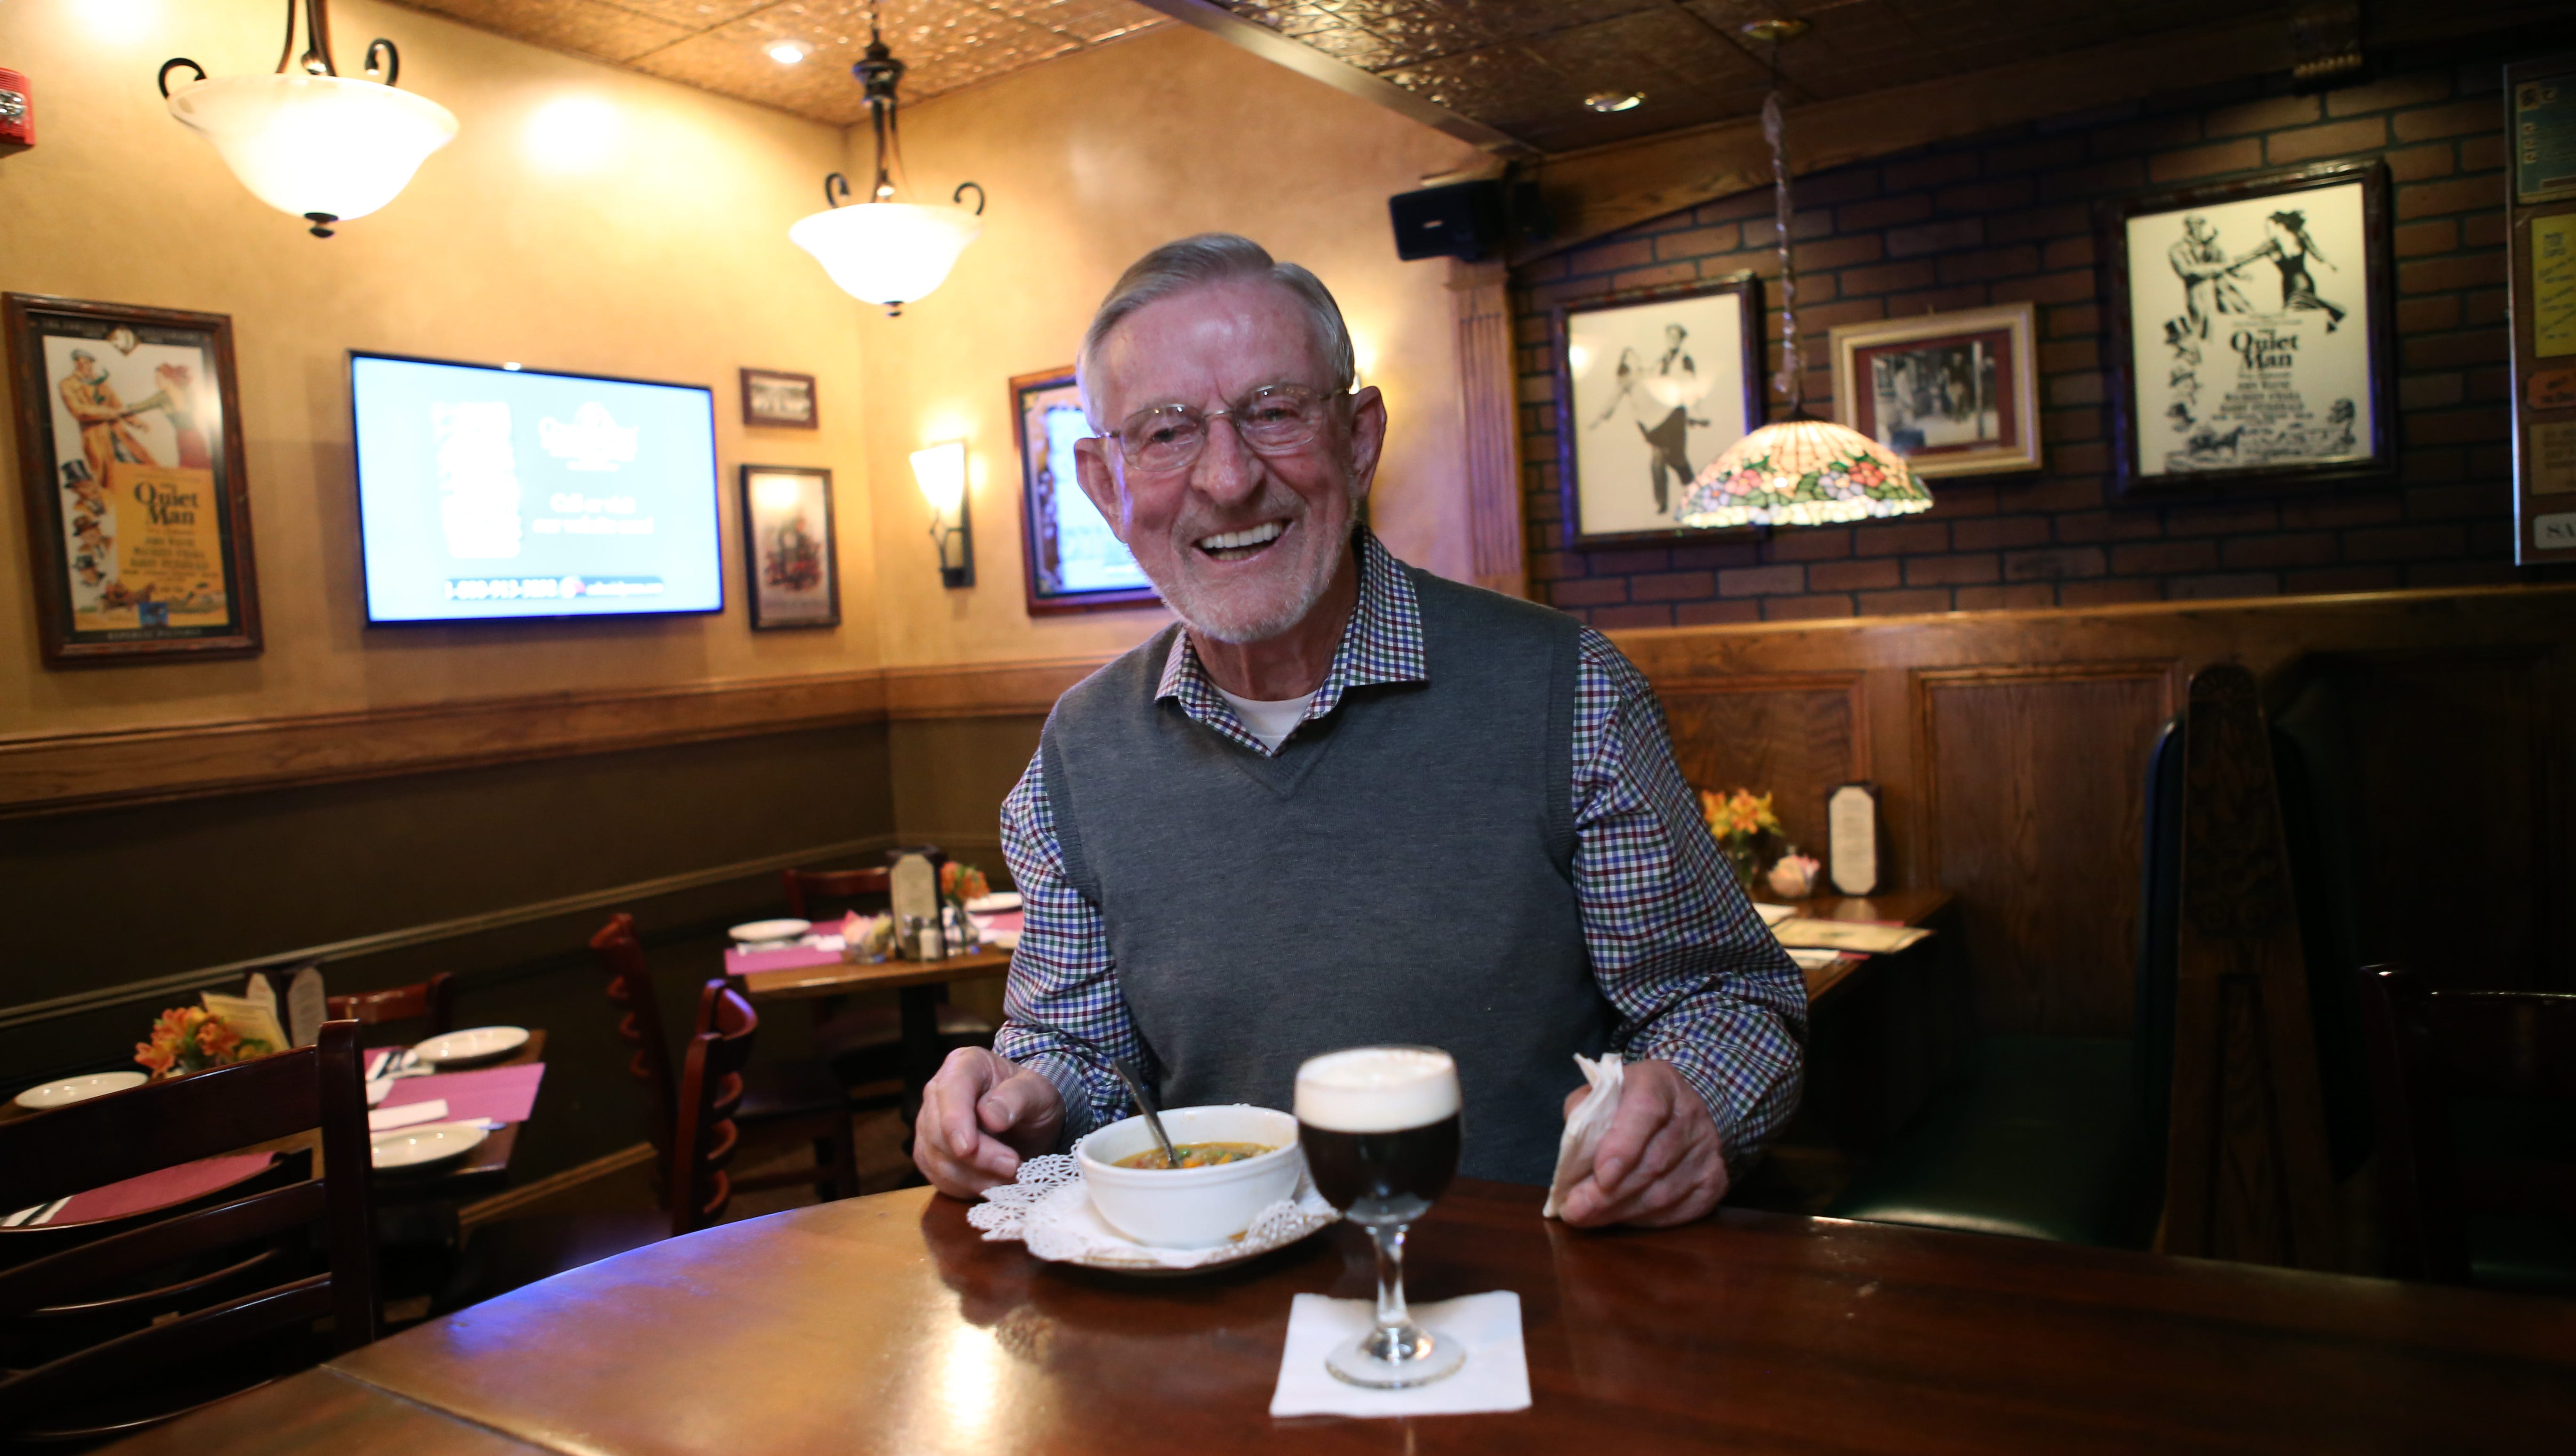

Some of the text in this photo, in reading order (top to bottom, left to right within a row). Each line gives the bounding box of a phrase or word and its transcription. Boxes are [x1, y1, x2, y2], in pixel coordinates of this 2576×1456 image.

[2230, 332, 2298, 352] Quiet
[2243, 352, 2292, 369] Man
[134, 482, 199, 508] Quiet
[146, 504, 195, 525] Man
